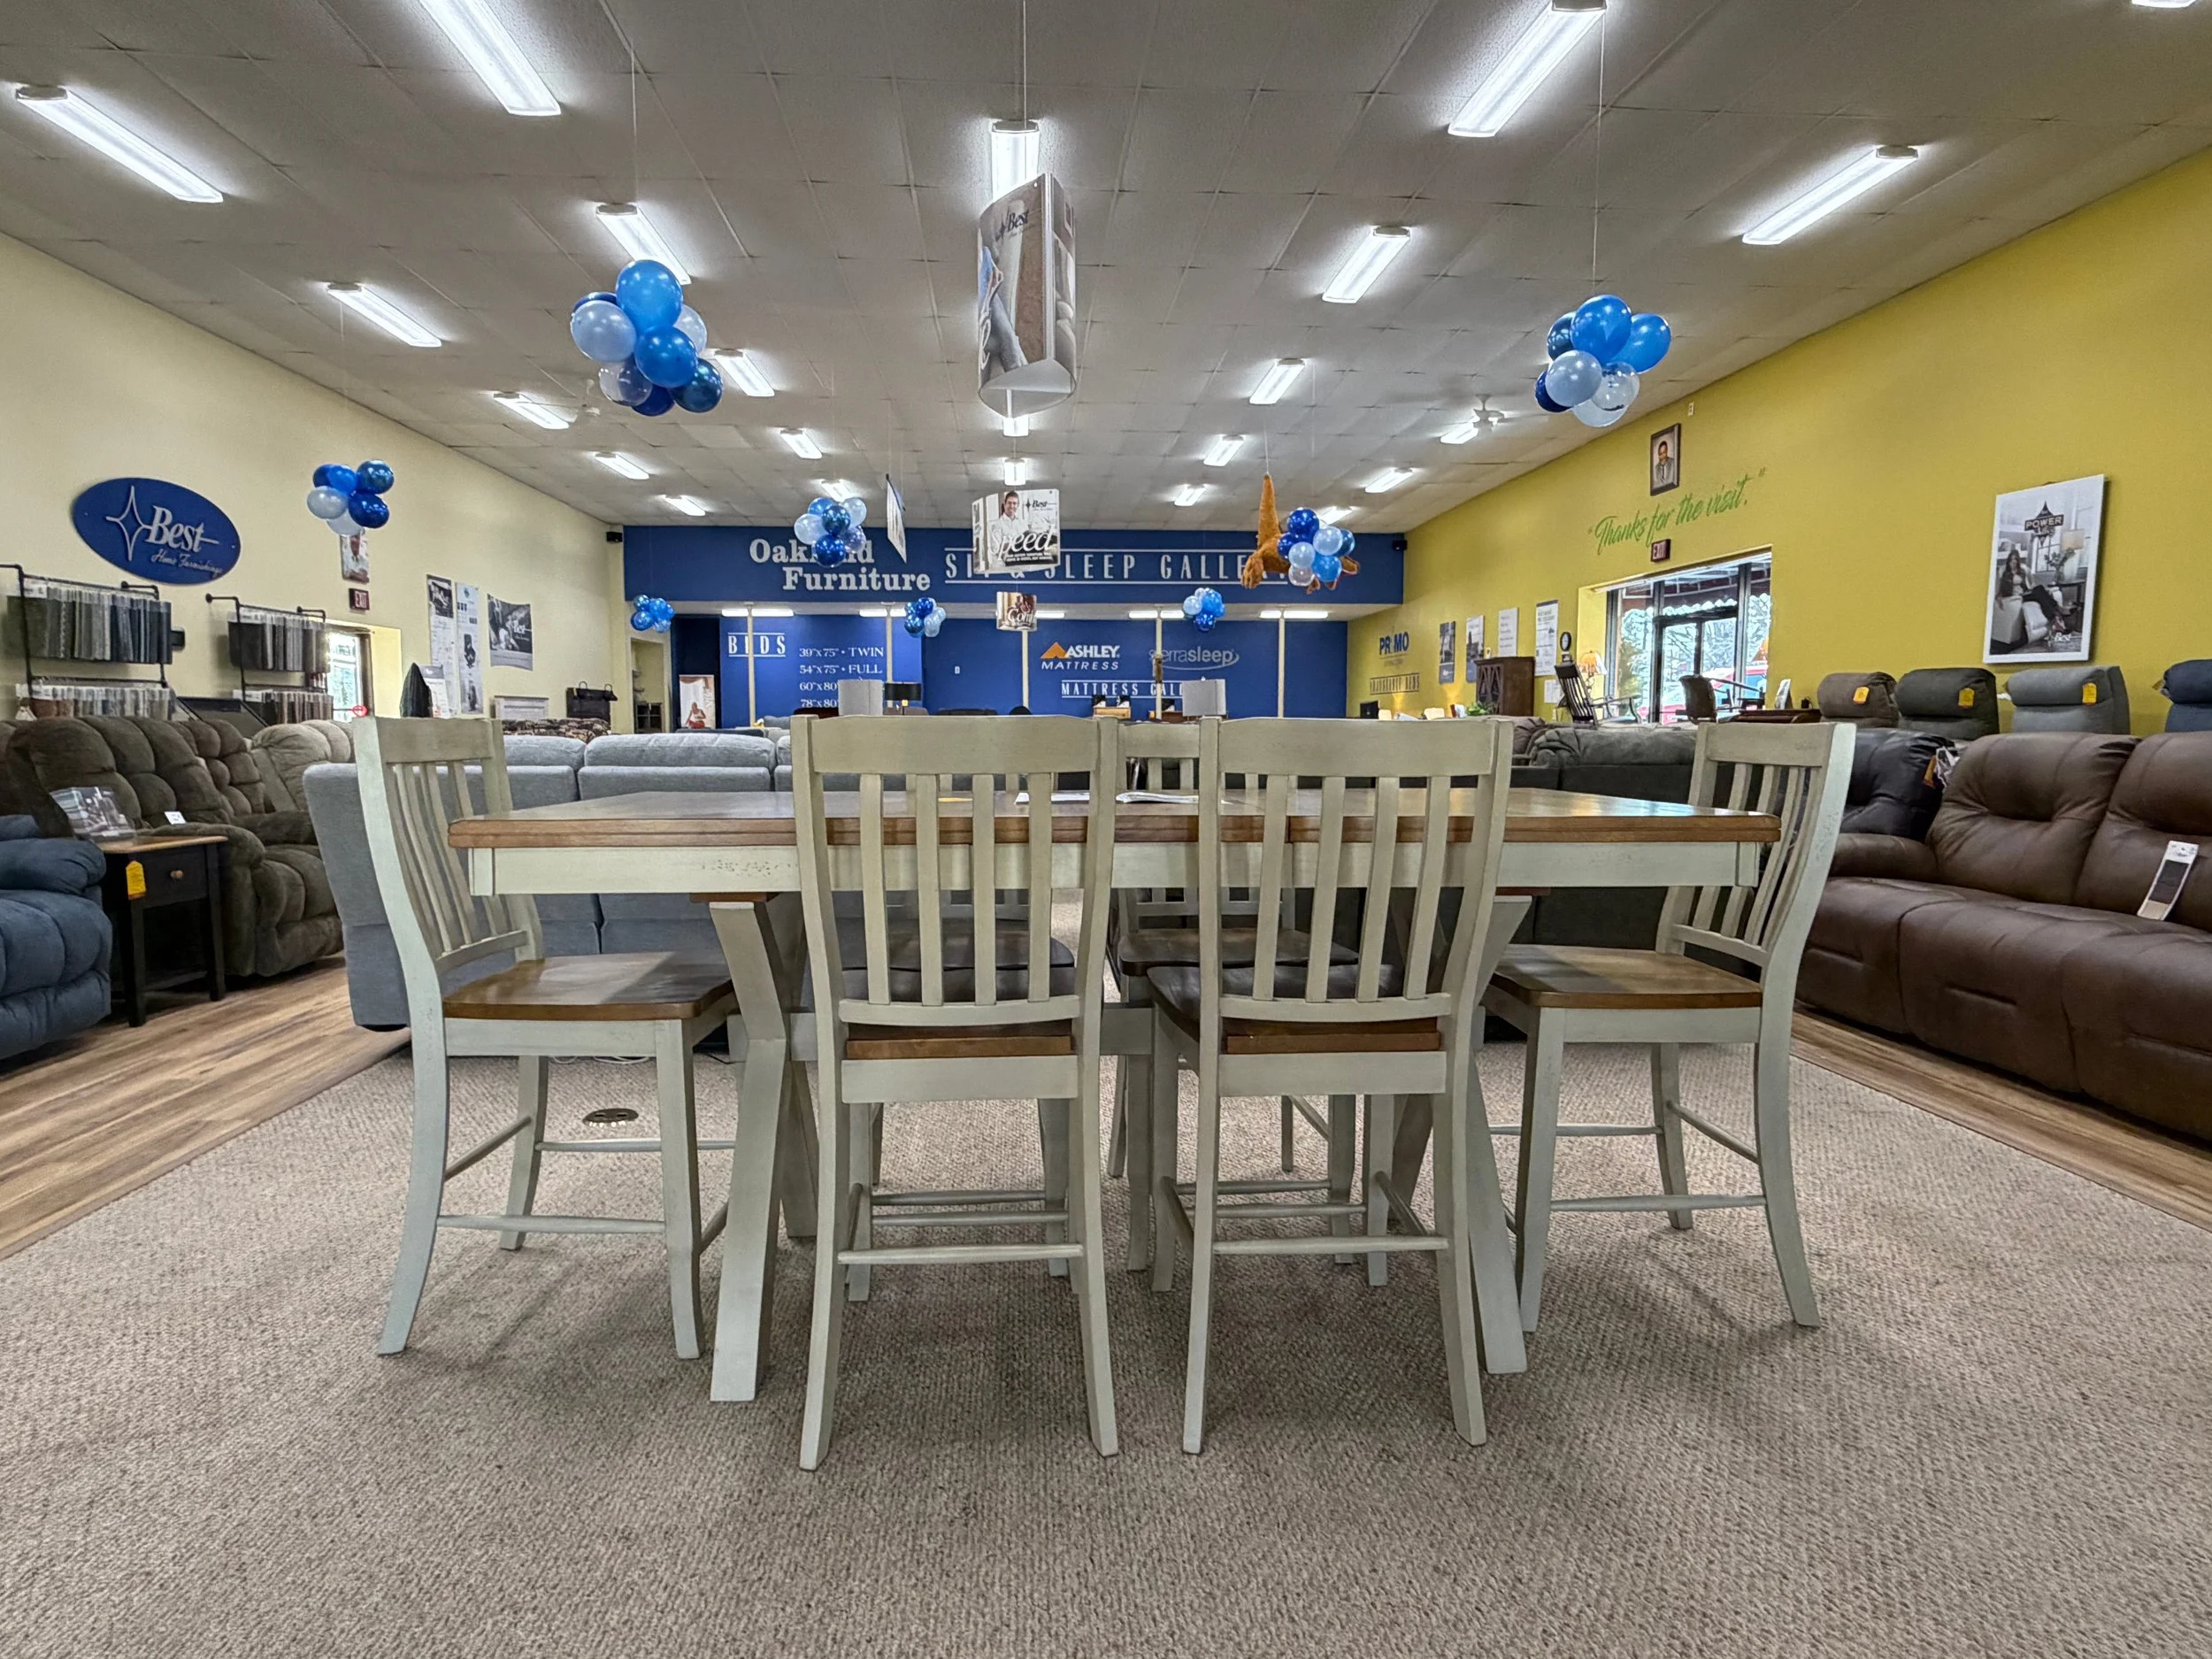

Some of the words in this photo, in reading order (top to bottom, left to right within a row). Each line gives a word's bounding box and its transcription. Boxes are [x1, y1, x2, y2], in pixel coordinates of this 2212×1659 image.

[1008, 209, 1030, 232] Best
[1032, 500, 1048, 509] Best
[145, 504, 219, 552] Best
[1646, 504, 1676, 548] for
[1676, 492, 1705, 525] the
[2025, 516, 2062, 529] POWER
[749, 539, 875, 564] Oakd
[990, 524, 1056, 562] Speed
[150, 548, 177, 565] Home
[945, 554, 990, 580] SI
[1160, 554, 1286, 580] GALLE
[782, 566, 931, 591] Furniture
[849, 647, 884, 657] TWIN
[1064, 645, 1118, 658] ASHLEY
[1379, 631, 1409, 655] PRMO
[1041, 661, 1119, 670] MATTRESS
[1148, 646, 1234, 666] serrasleep
[849, 664, 883, 674] FULL
[1062, 683, 1139, 695] MATTRESS
[1150, 683, 1184, 695] GALL
